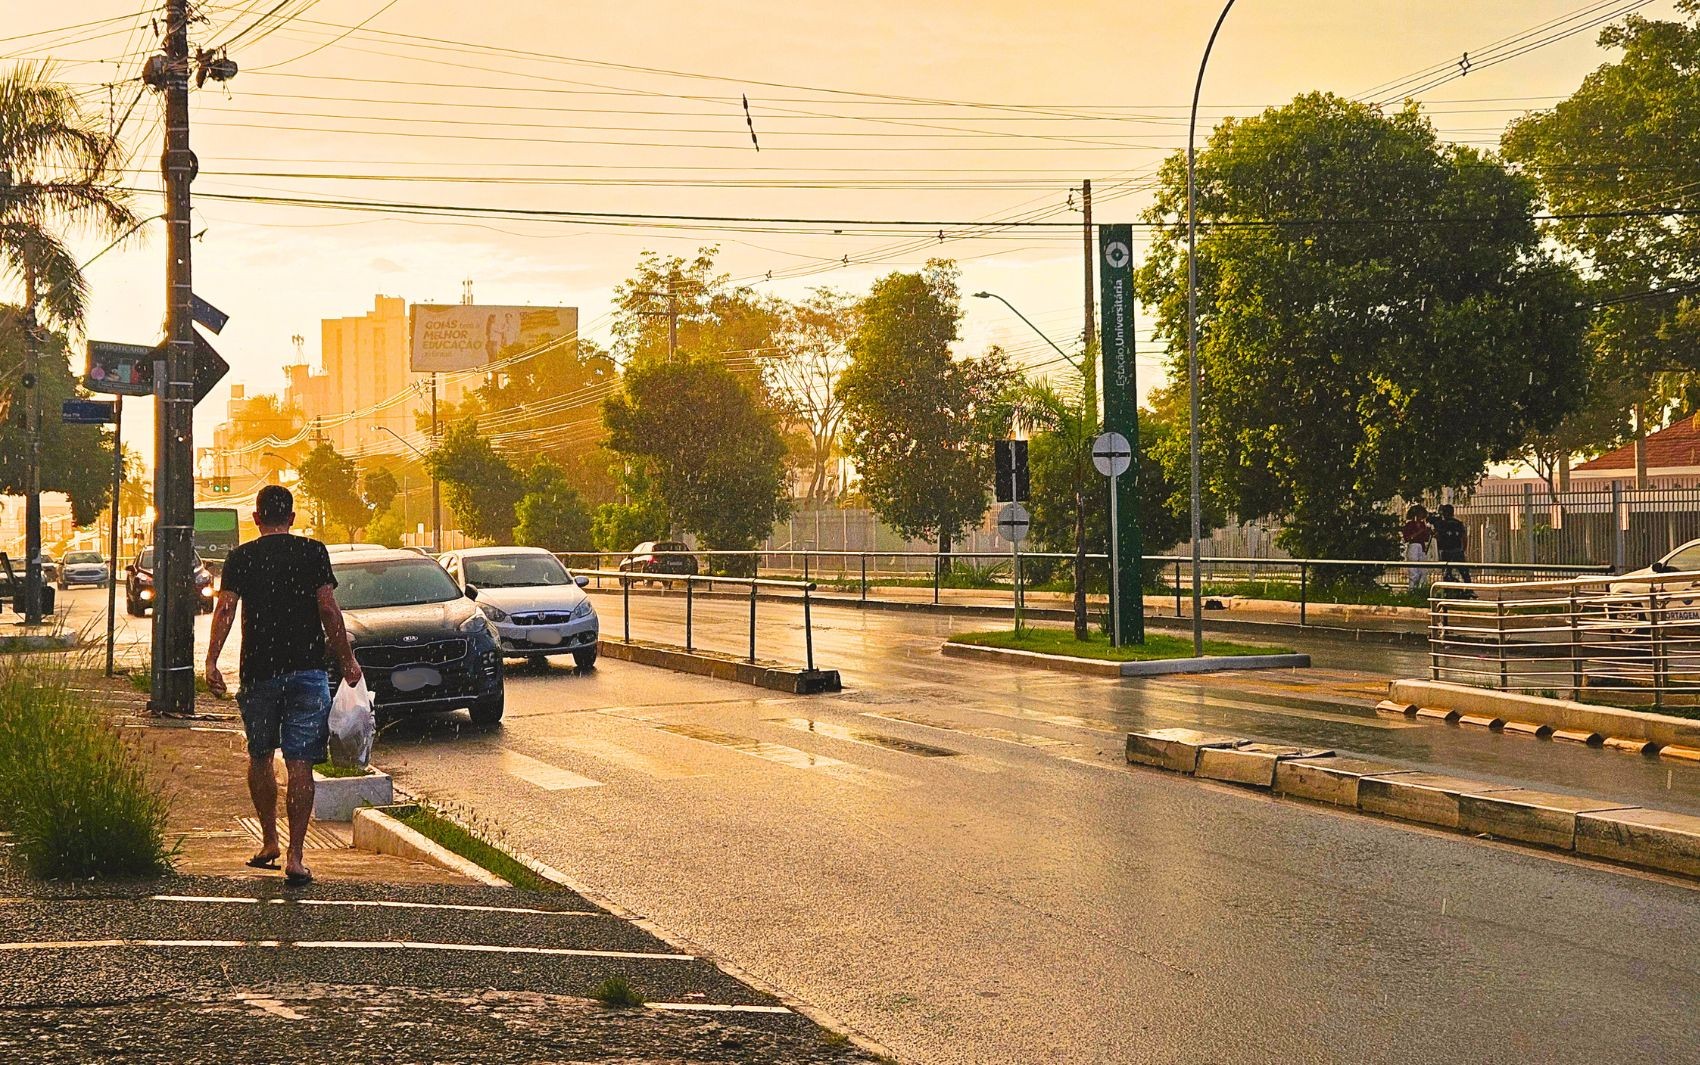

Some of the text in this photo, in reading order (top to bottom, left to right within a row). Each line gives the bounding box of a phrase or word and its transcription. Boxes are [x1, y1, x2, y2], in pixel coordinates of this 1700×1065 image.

[423, 330, 468, 340] MELHOR
[1114, 279, 1125, 386] Estação Universitária
[422, 338, 482, 352] EDUCAÇÃO
